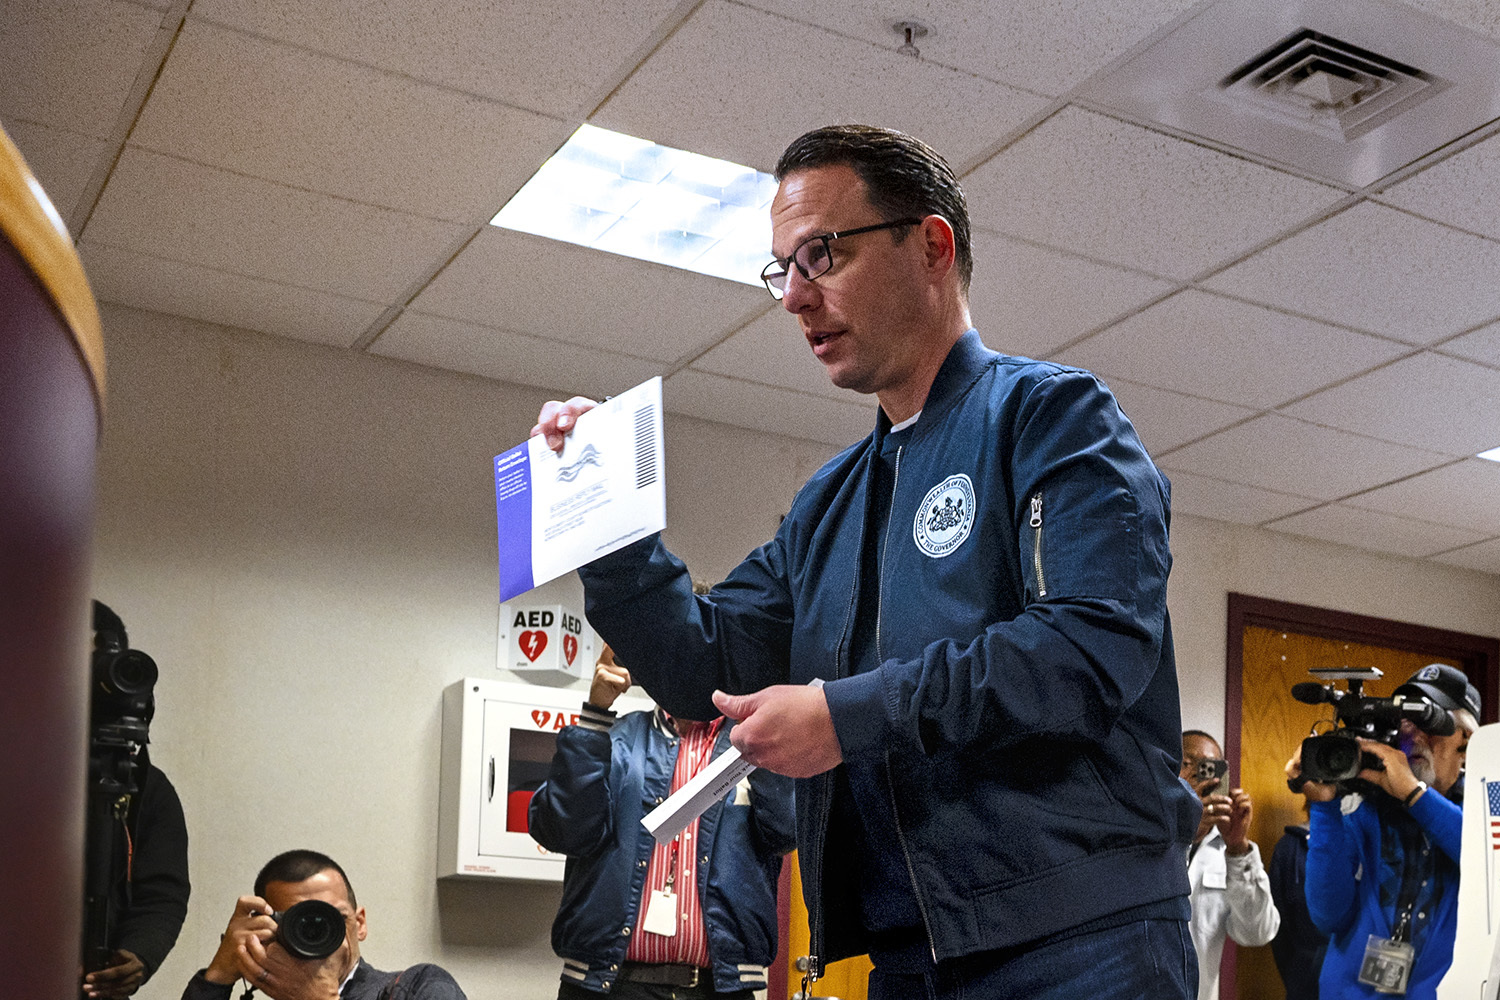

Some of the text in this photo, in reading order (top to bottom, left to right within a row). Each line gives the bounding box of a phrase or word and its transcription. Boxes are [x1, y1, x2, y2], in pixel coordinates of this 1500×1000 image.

[513, 611, 554, 628] AED
[561, 613, 582, 635] AED
[553, 712, 580, 730] AE
